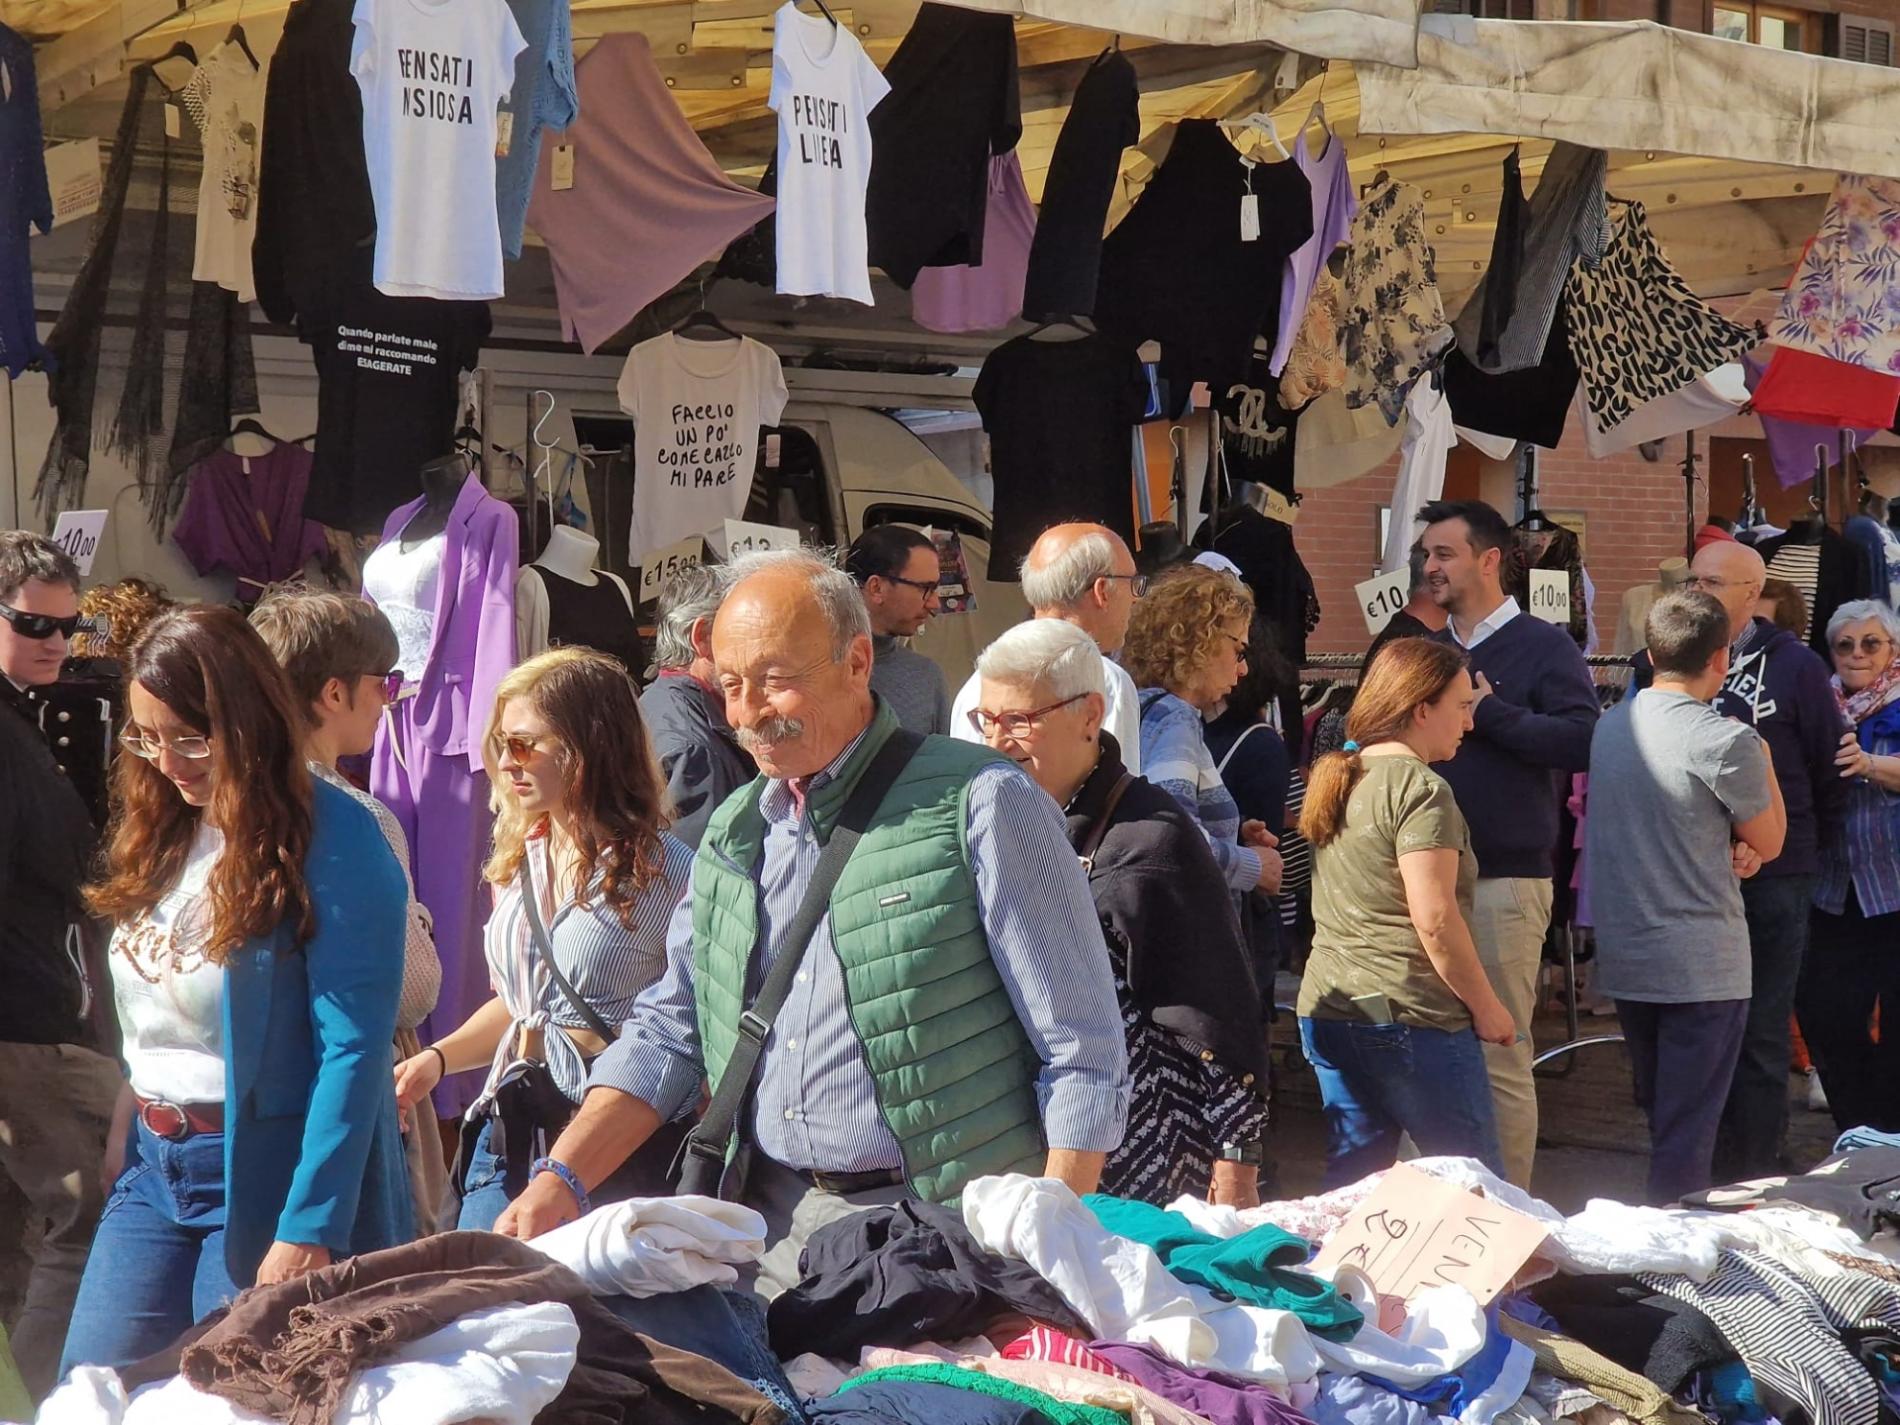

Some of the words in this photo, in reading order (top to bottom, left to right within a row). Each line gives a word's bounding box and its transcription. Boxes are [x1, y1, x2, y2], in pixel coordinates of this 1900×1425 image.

[337, 325, 374, 339] Quando
[374, 332, 412, 346] parlate
[412, 338, 438, 350] male
[357, 357, 412, 375] ESAGERATE
[374, 348, 437, 364] raccomando
[672, 404, 733, 424] FACCIO
[675, 427, 697, 446] UN
[706, 423, 728, 443] PO'
[658, 447, 700, 466] COME
[670, 469, 686, 487] MI
[694, 462, 735, 488] PARE
[1367, 586, 1404, 618] €10
